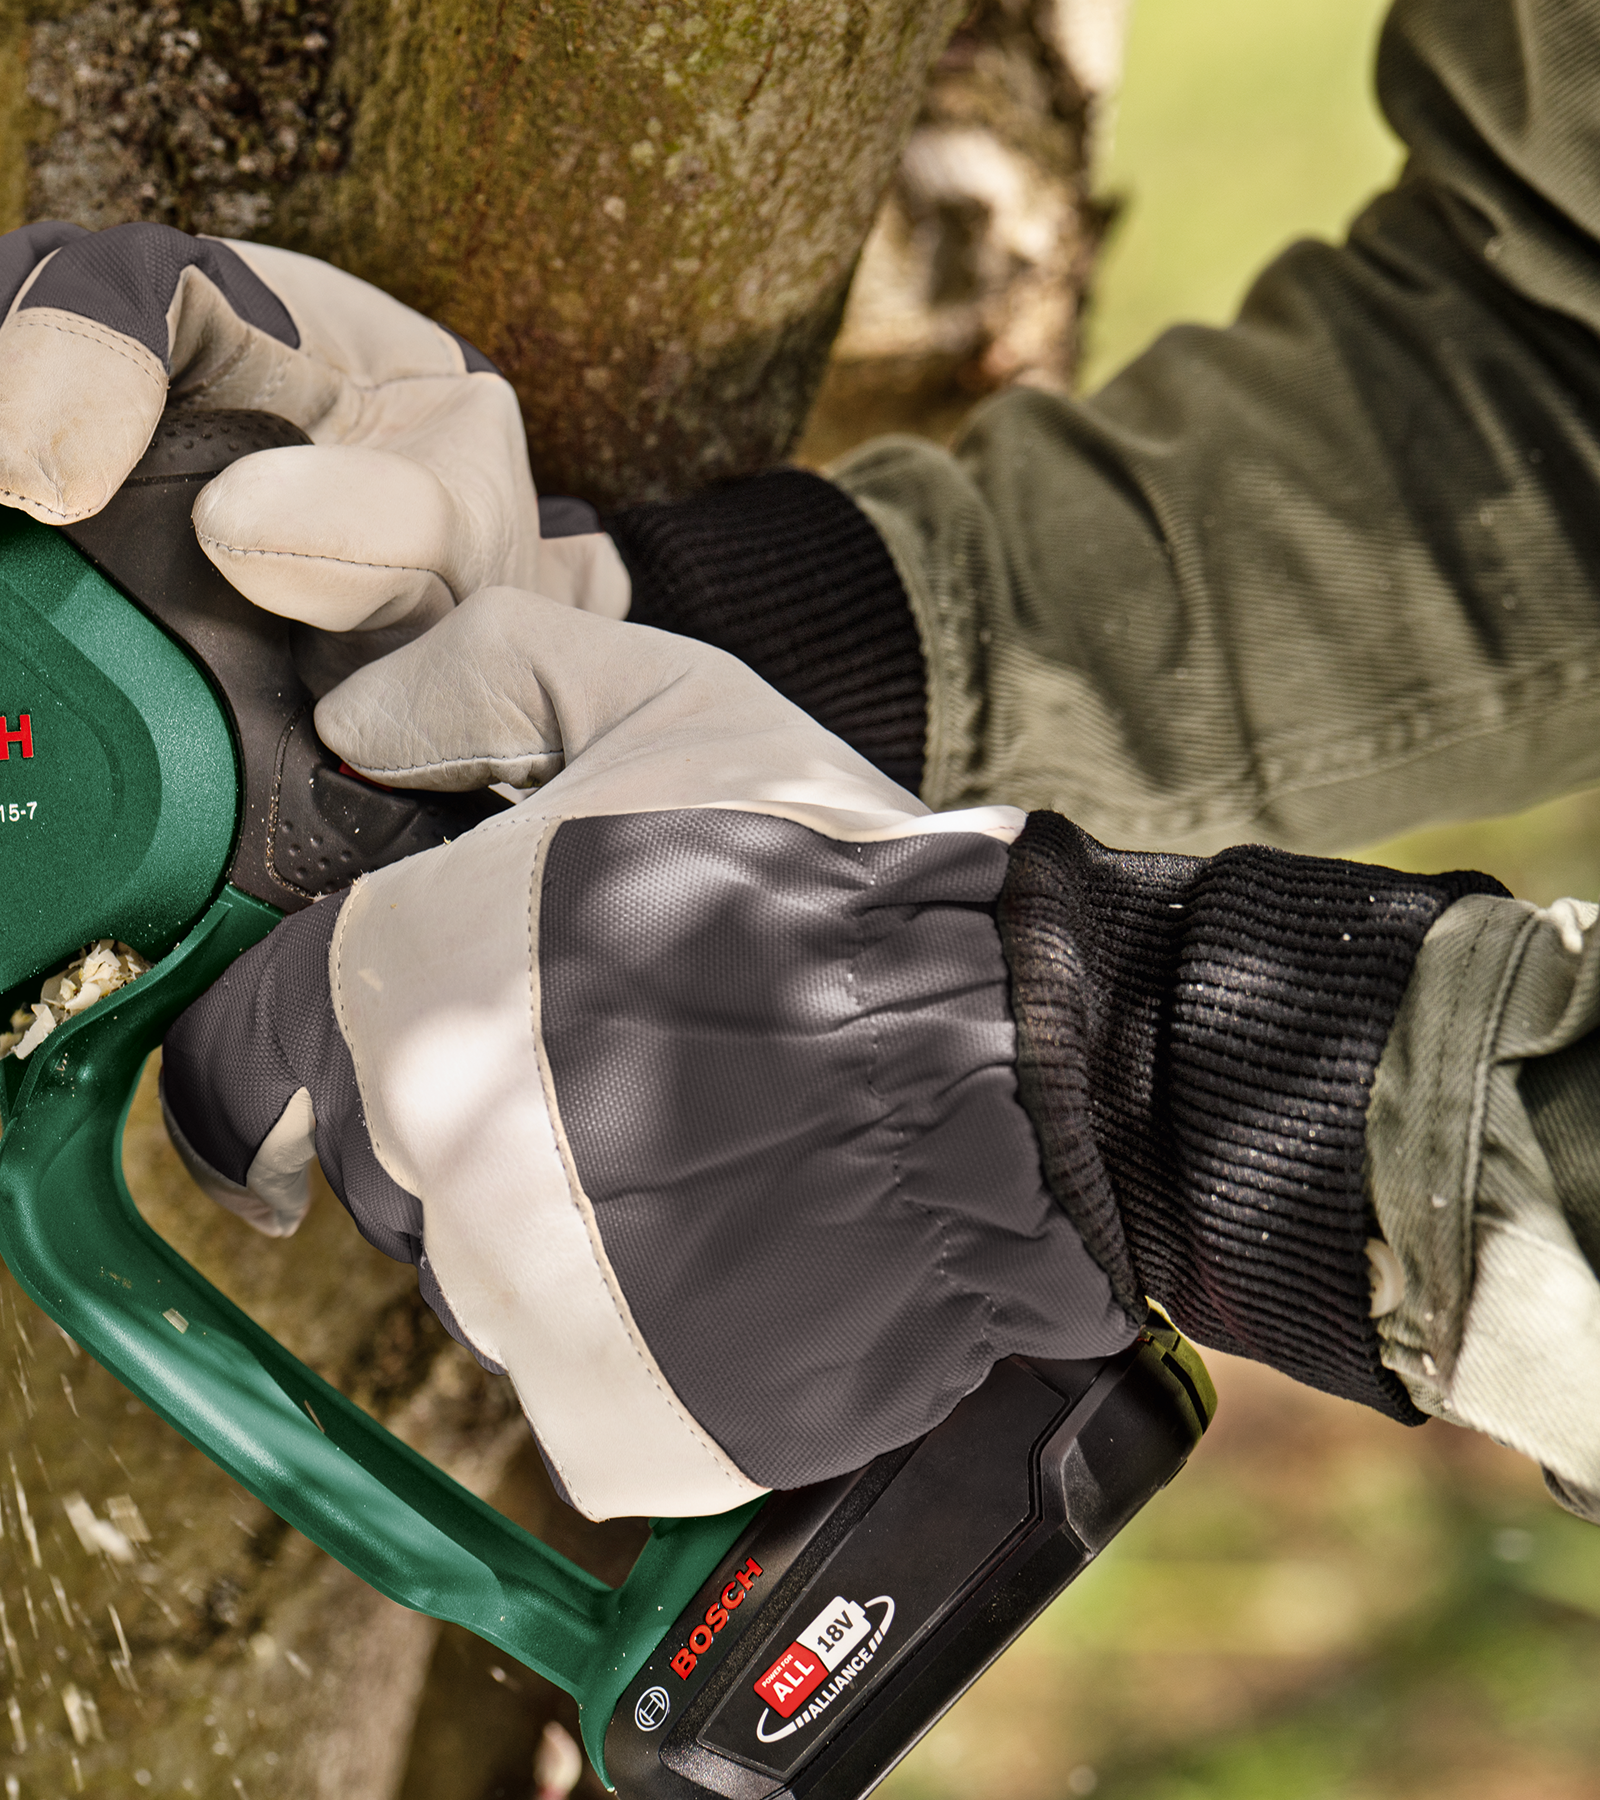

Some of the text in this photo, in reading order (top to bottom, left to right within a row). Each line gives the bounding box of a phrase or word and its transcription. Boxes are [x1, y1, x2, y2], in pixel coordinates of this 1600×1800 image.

[670, 1557, 763, 1681] BOSCH
[816, 1610, 854, 1653] 18V
[761, 1654, 794, 1688] POWER FOR
[772, 1660, 815, 1703] ALL
[808, 1647, 874, 1720] ALLIANCE
